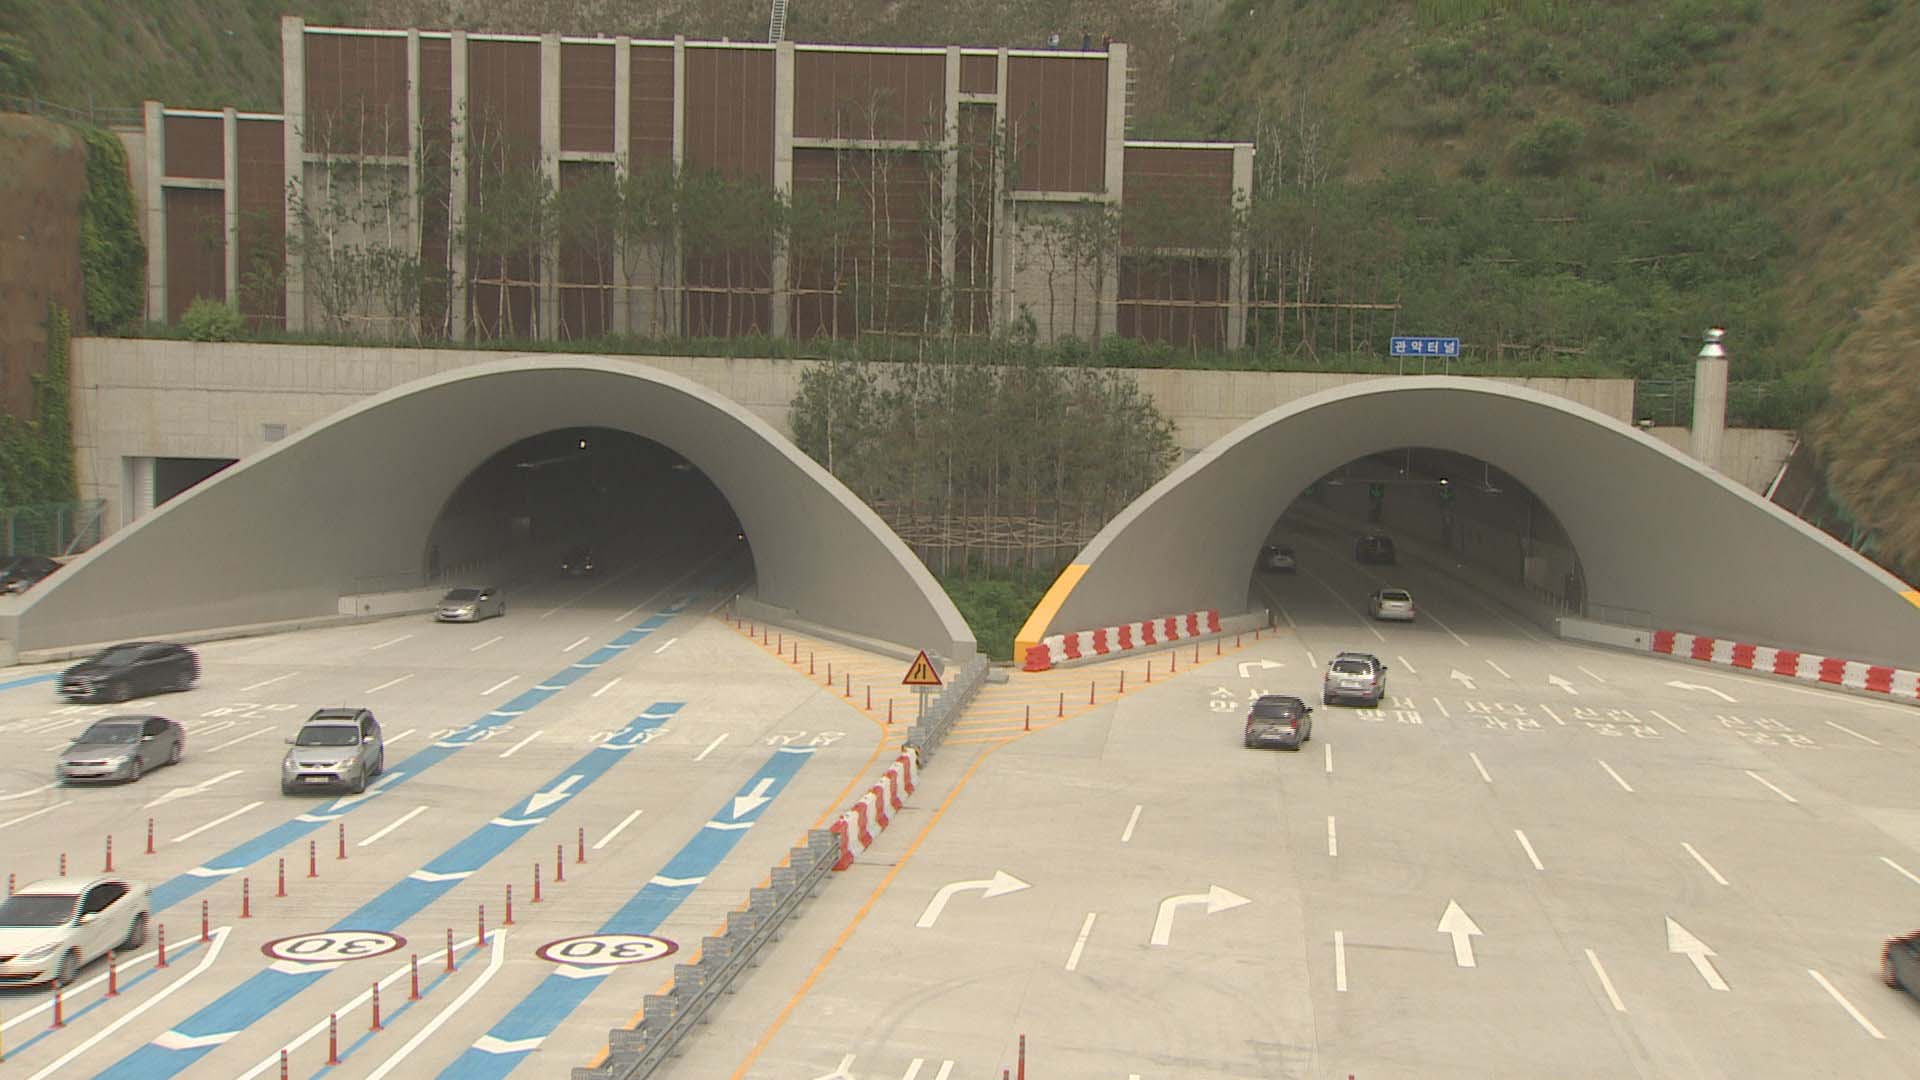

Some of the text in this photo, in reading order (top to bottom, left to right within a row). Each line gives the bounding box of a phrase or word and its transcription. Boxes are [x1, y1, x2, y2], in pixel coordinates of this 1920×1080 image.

[1394, 341, 1455, 354] 관악터널
[286, 937, 387, 955] 30
[558, 941, 656, 959] 30
